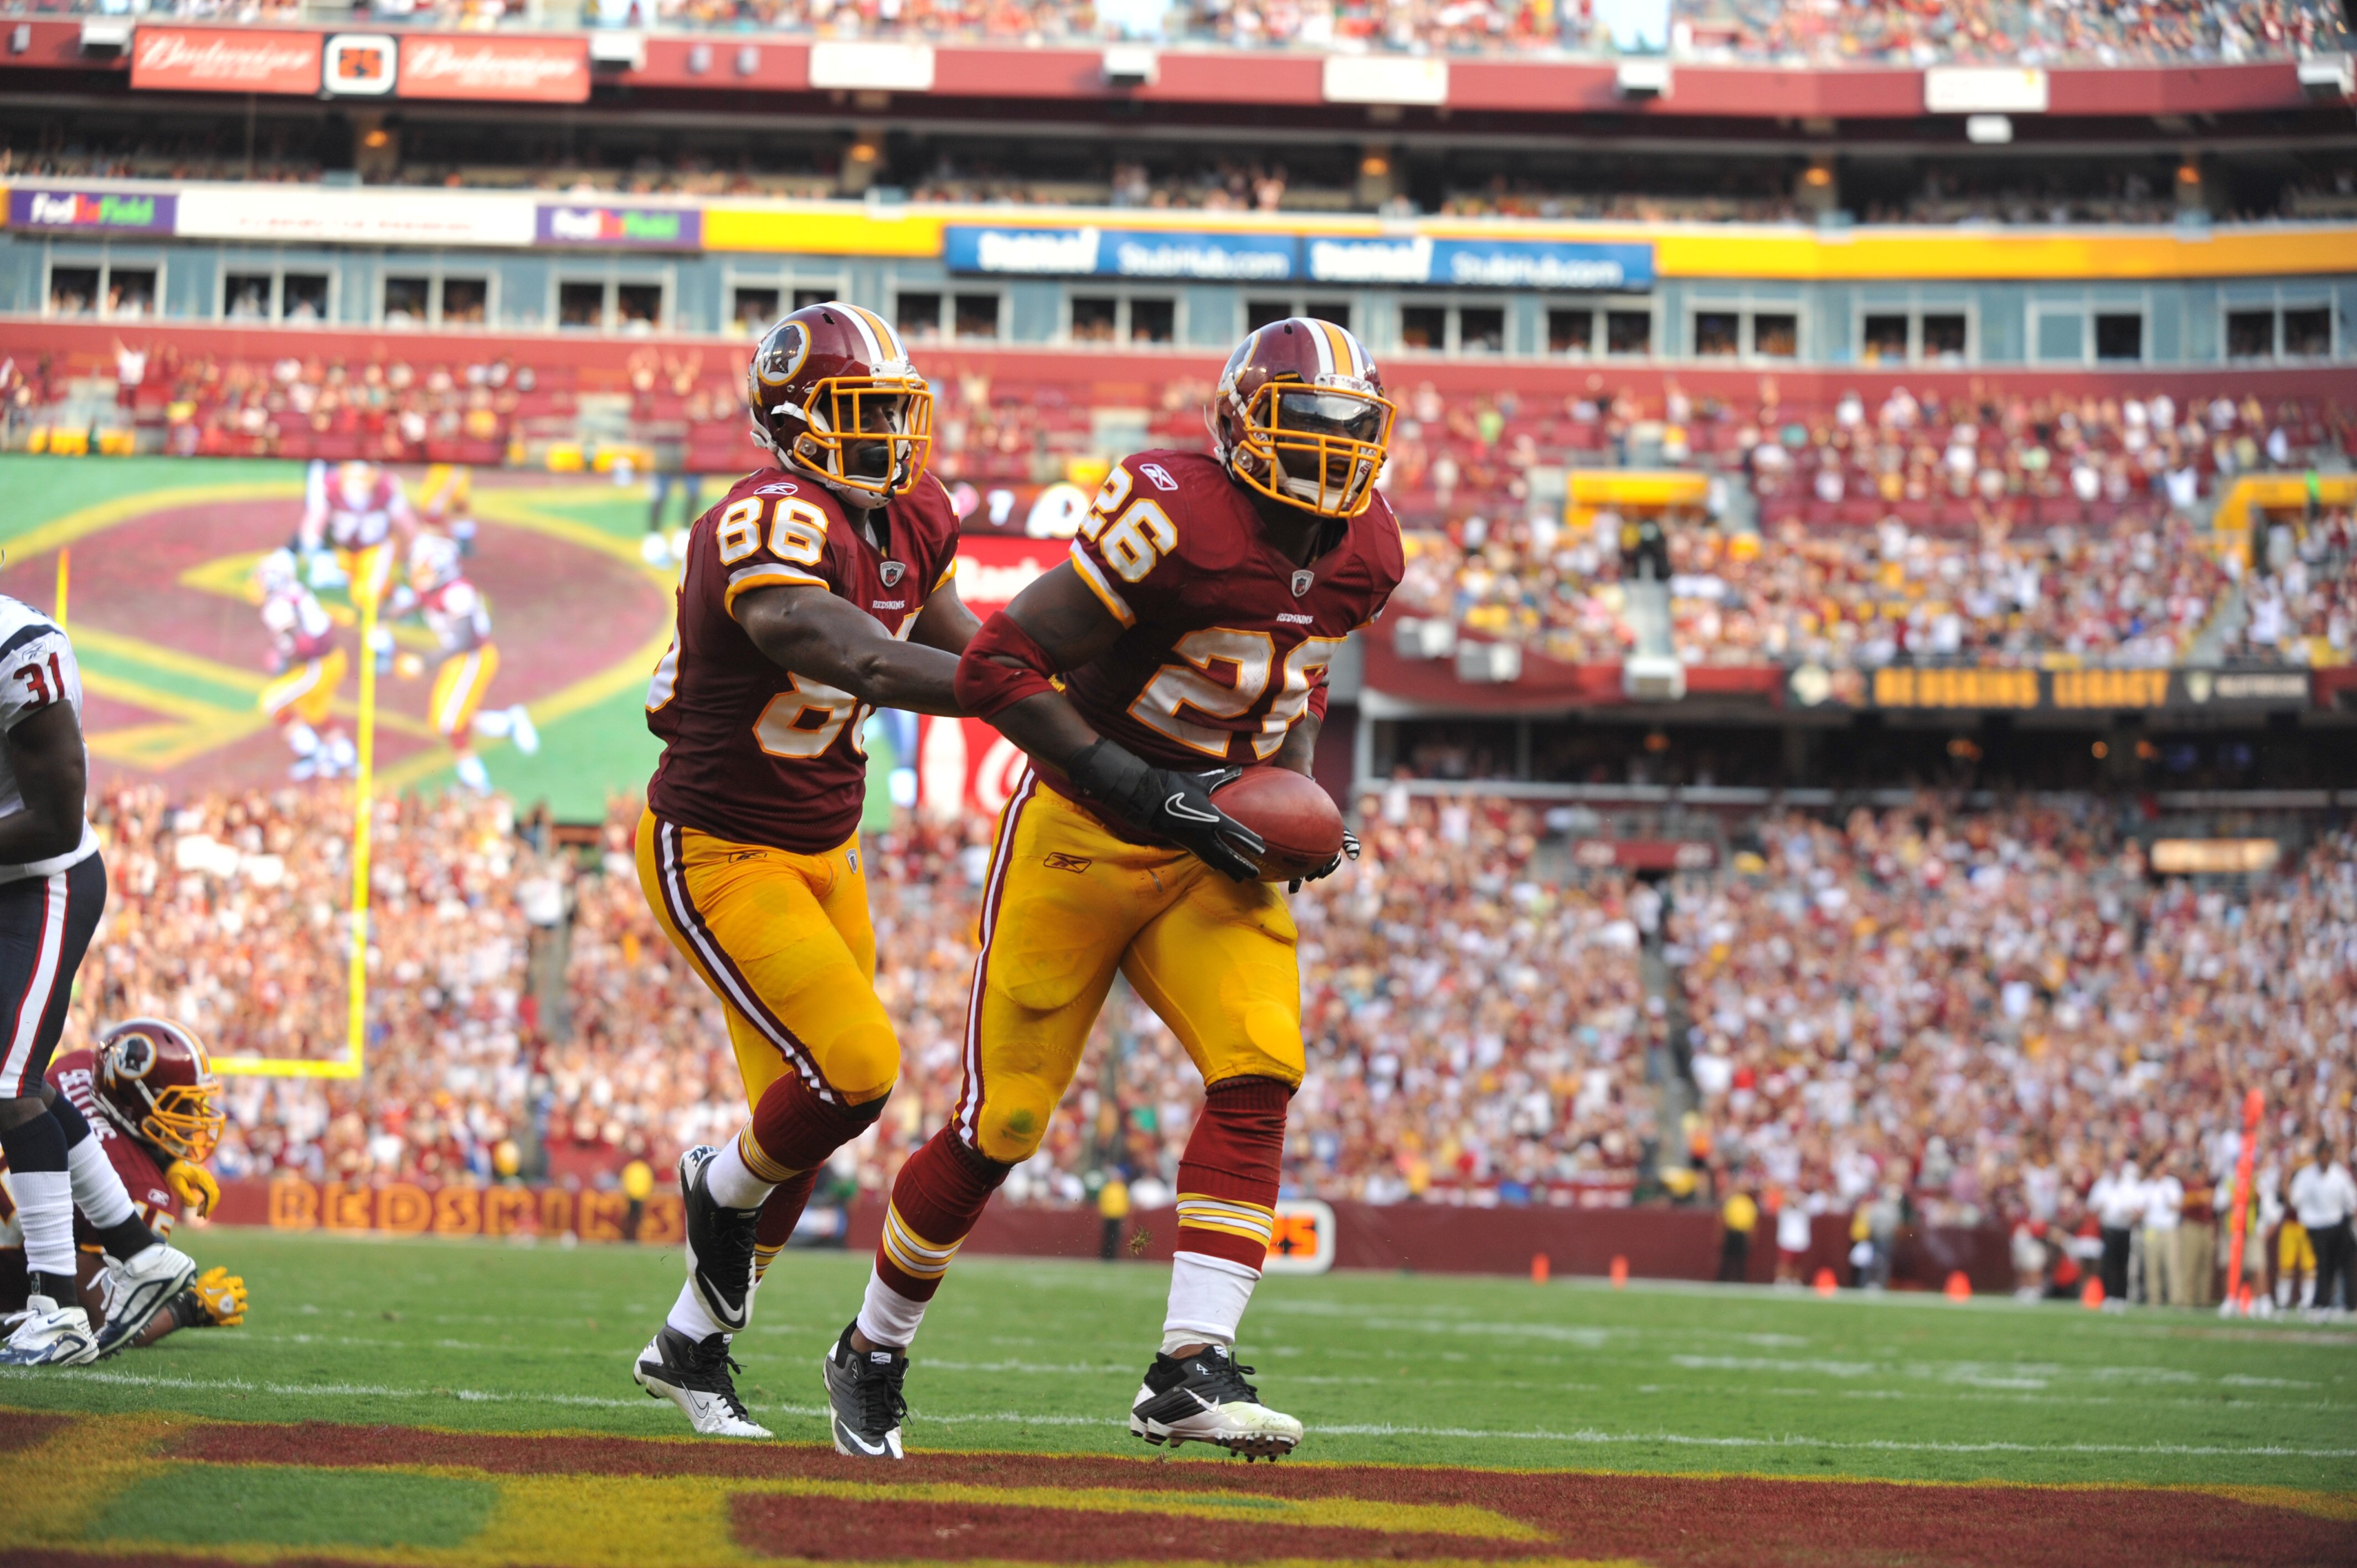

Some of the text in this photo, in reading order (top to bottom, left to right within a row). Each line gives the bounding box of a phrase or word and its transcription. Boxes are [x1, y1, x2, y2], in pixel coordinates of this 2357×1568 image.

[717, 496, 830, 567] 86
[1078, 463, 1177, 584] 26
[872, 600, 905, 610] REDSKINS
[1276, 613, 1314, 625] REDSKINS
[13, 651, 65, 711] 31
